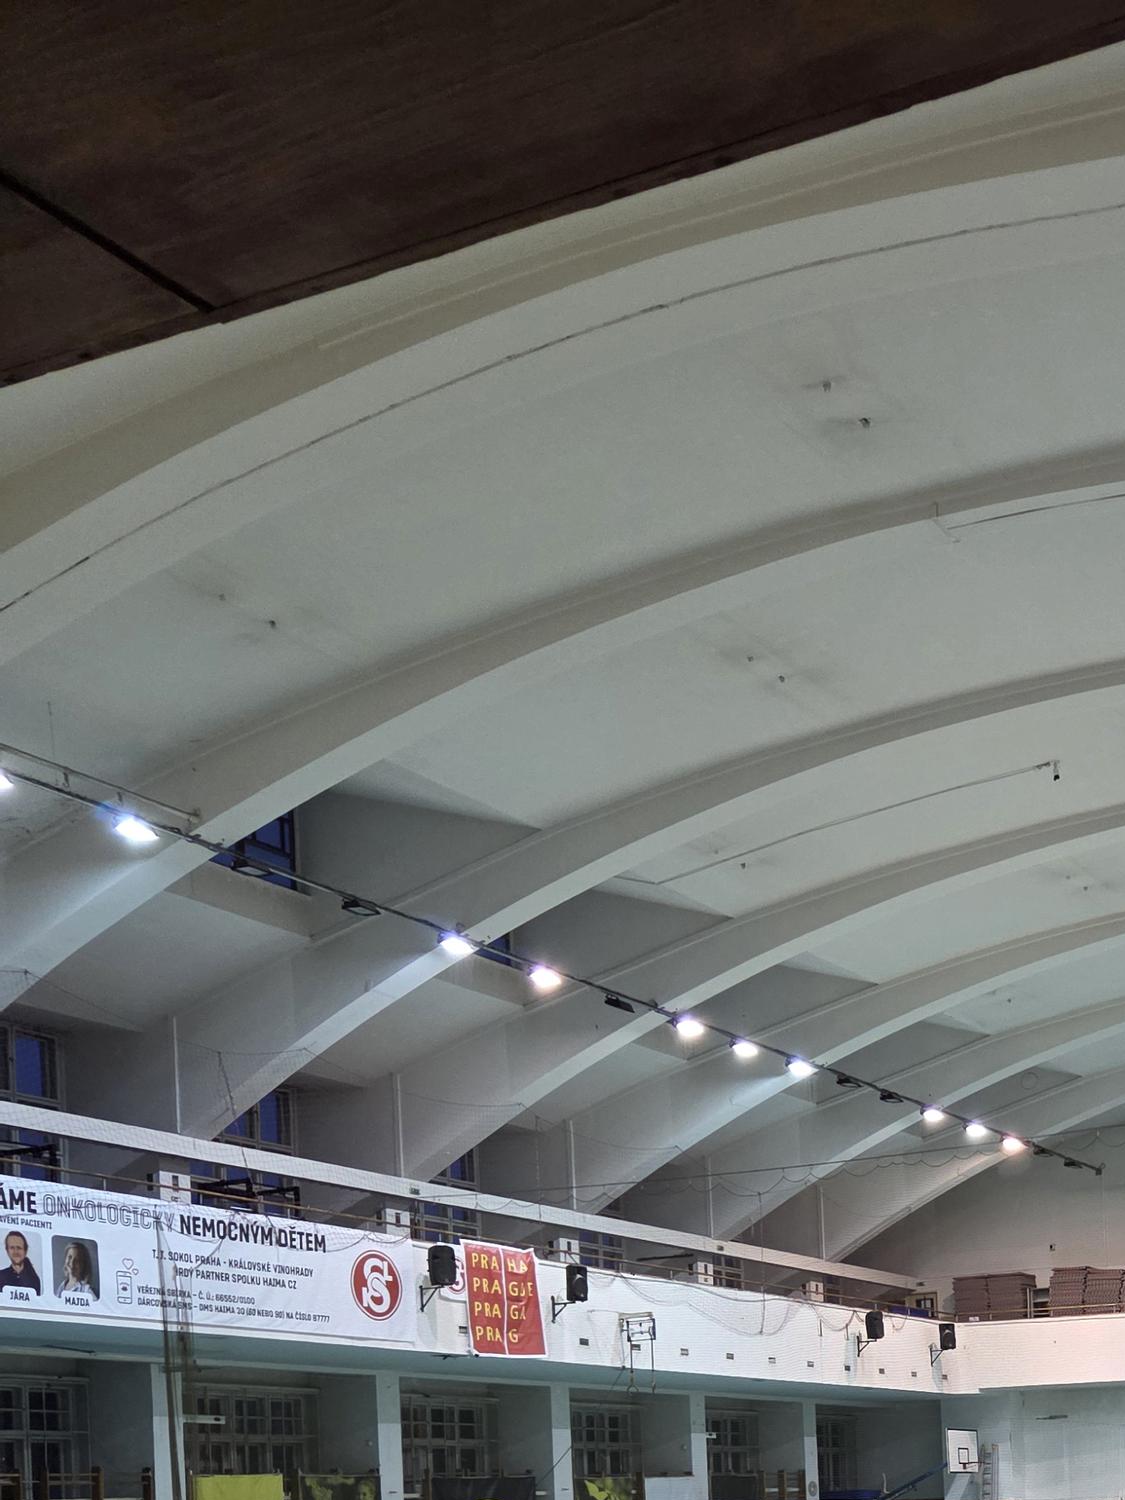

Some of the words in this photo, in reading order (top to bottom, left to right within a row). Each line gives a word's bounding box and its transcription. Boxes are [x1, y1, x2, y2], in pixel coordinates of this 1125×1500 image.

[20, 1218, 52, 1229] PACIENTI
[179, 1214, 272, 1246] NEMOCNÝM
[276, 1226, 327, 1253] DĚTEM
[168, 1251, 193, 1264] SOKOL
[195, 1254, 221, 1267] PRAHA
[228, 1257, 271, 1273] KRÁLOVSKÉ
[272, 1263, 314, 1278] VINOHRADY
[195, 1269, 230, 1283] PARTNER
[231, 1273, 261, 1286] SPOLKU
[288, 1280, 297, 1290] CZ
[10, 1289, 30, 1302] JÁRA
[65, 1296, 90, 1307] MAJDA
